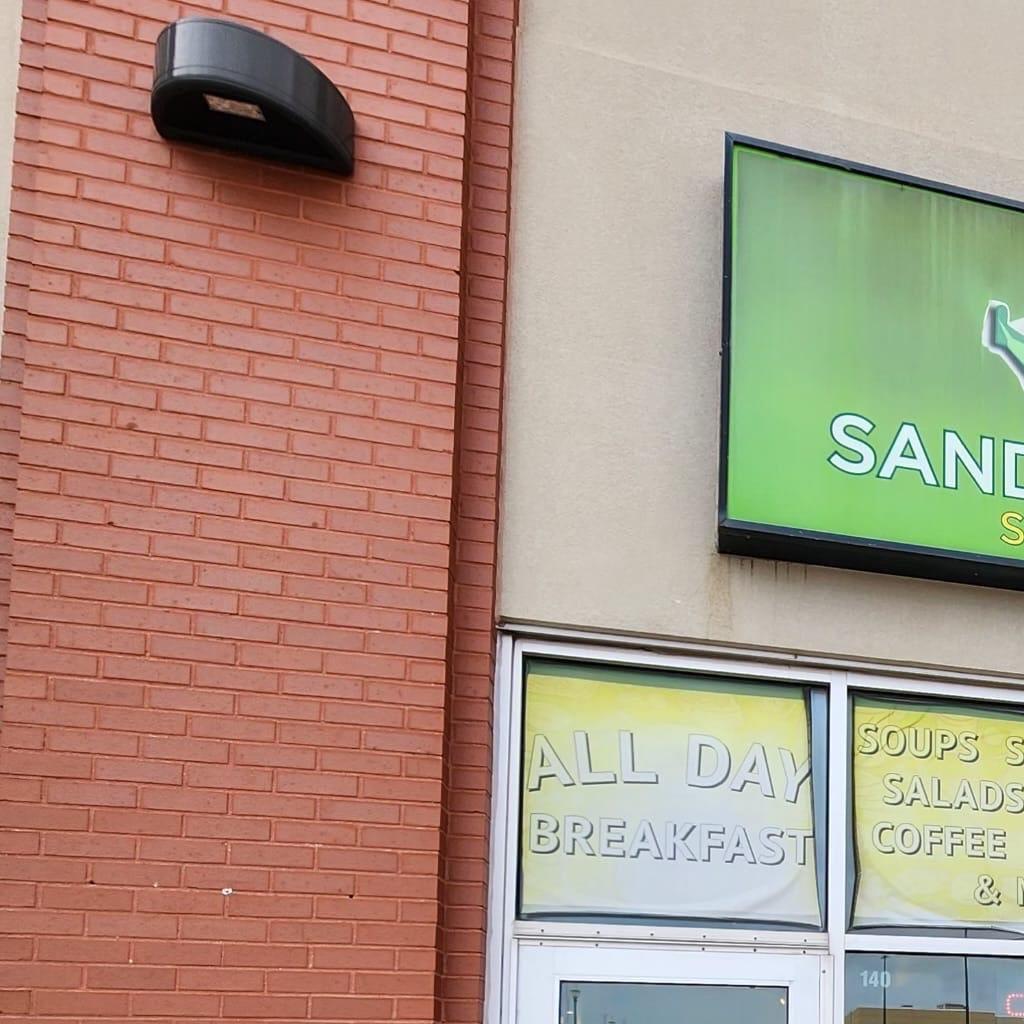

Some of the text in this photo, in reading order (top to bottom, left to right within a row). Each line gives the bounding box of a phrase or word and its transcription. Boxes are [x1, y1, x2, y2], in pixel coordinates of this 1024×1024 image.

[857, 723, 979, 763] SOUPS
[527, 730, 811, 804] ALL DAY
[528, 812, 815, 867] BREAKFAST
[872, 822, 1007, 860] COFFEE
[973, 873, 1002, 907] &
[860, 970, 890, 988] 140
